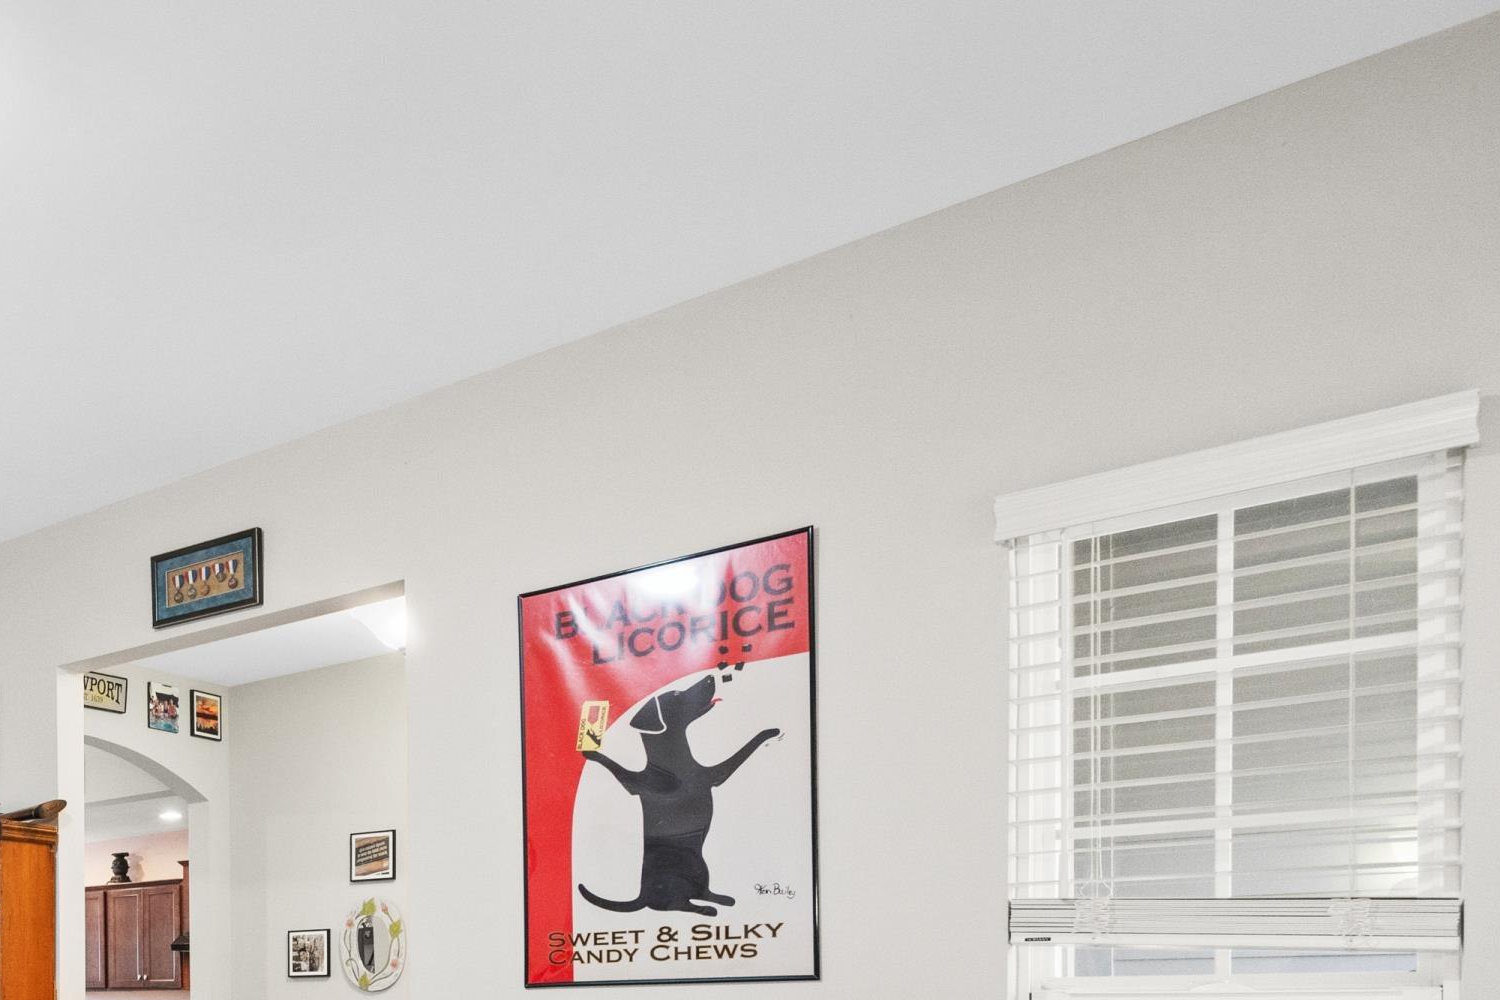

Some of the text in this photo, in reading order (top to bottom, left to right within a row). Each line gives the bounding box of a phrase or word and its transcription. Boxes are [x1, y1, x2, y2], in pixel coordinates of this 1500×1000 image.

[591, 598, 796, 665] LICORICE
[548, 922, 785, 948] SWEET & SILKY
[548, 943, 758, 966] CANDY CHEWS
